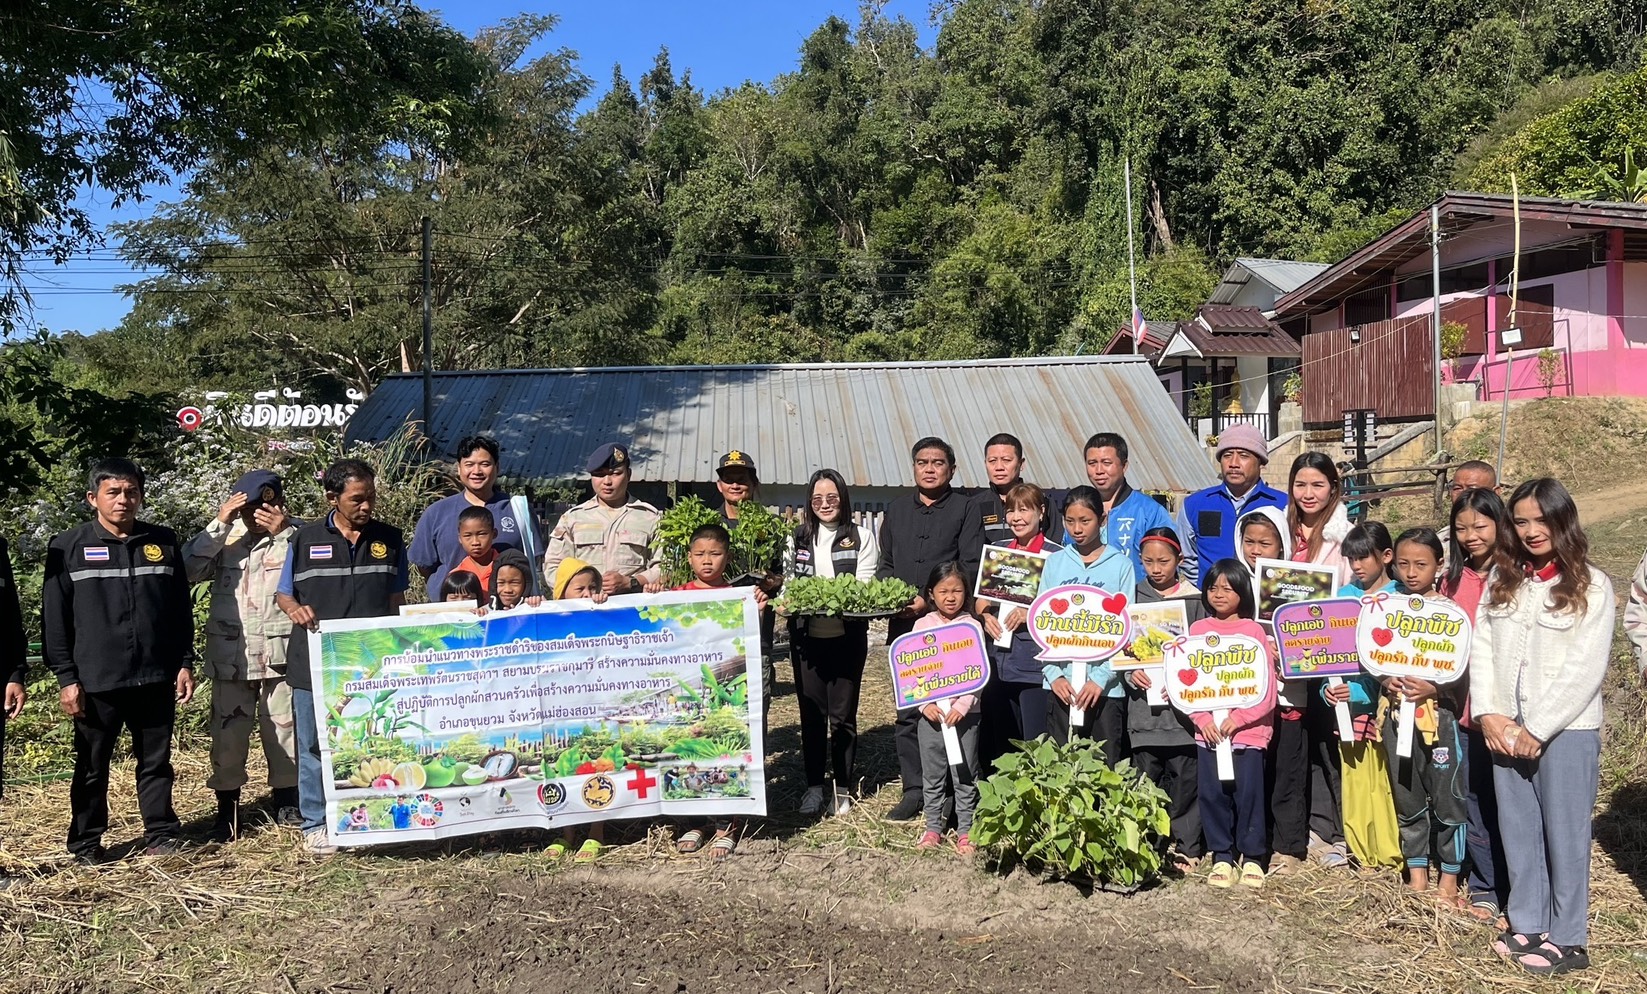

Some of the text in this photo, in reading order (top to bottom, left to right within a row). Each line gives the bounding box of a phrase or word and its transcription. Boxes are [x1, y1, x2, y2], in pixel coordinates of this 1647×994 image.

[1035, 608, 1124, 635] บ้านนี้มีรัก
[1280, 616, 1358, 636] ปลูกเอง กินเอ
[1385, 610, 1464, 638] ปลูกพืช
[896, 638, 973, 666] ปลูกเอง กินเอง
[1045, 634, 1115, 648] ปลูกผักกินเอง
[1285, 635, 1331, 648] ลดรายจ่าย
[1412, 637, 1455, 653] ปลูกผัก
[1188, 644, 1258, 674] ปลูกพืช
[1369, 649, 1455, 671] ปลูกรัก กับ พช.
[345, 669, 498, 692] กรมสมเด็จพระเทพรัตนราชสุดาฯ
[598, 650, 723, 669] สร้างความมั่นคงทางอาหาร
[924, 665, 981, 691] เพิ่มรายได้
[1216, 667, 1255, 683] ปลูกผัก
[1179, 685, 1258, 703] ปลูกรัก กับ พช.
[439, 706, 596, 731] อำเภอขุนยวม จังหวัดแม่ฮ่องสอน
